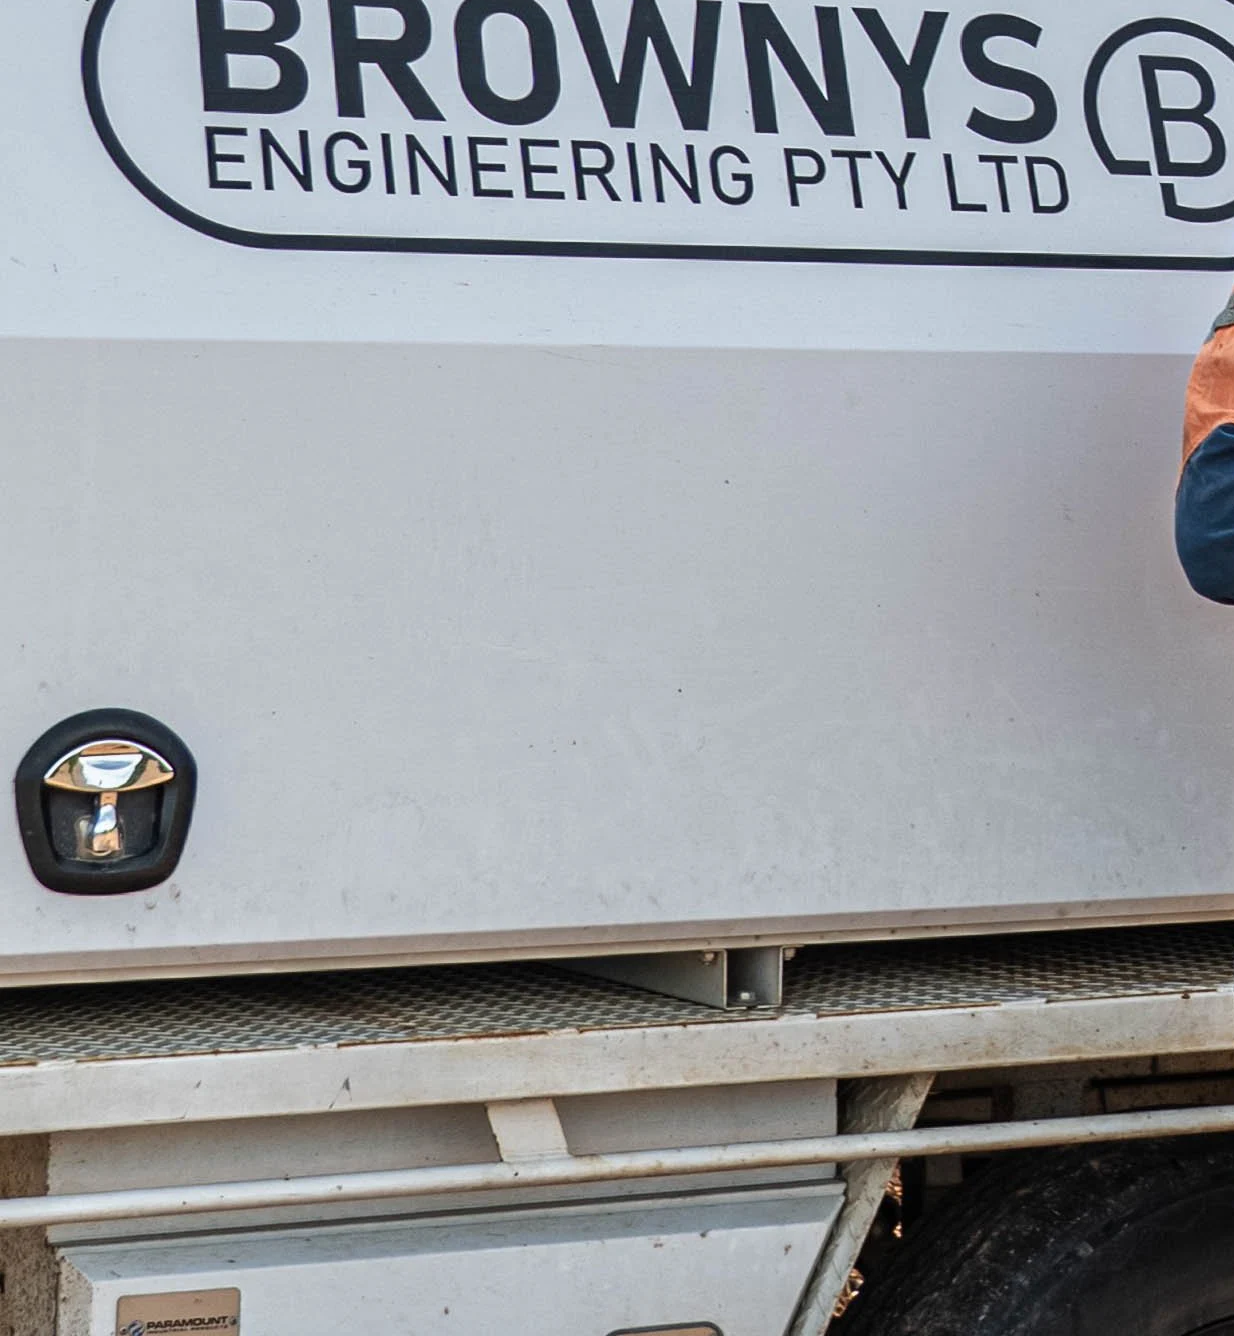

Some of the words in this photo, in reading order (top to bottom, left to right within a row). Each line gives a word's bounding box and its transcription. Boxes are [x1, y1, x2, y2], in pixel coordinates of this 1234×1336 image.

[205, 125, 756, 207] ENGINEERING
[783, 146, 917, 211] PTY
[942, 152, 1070, 215] LTD
[146, 1315, 229, 1330] PARAMOUNT
